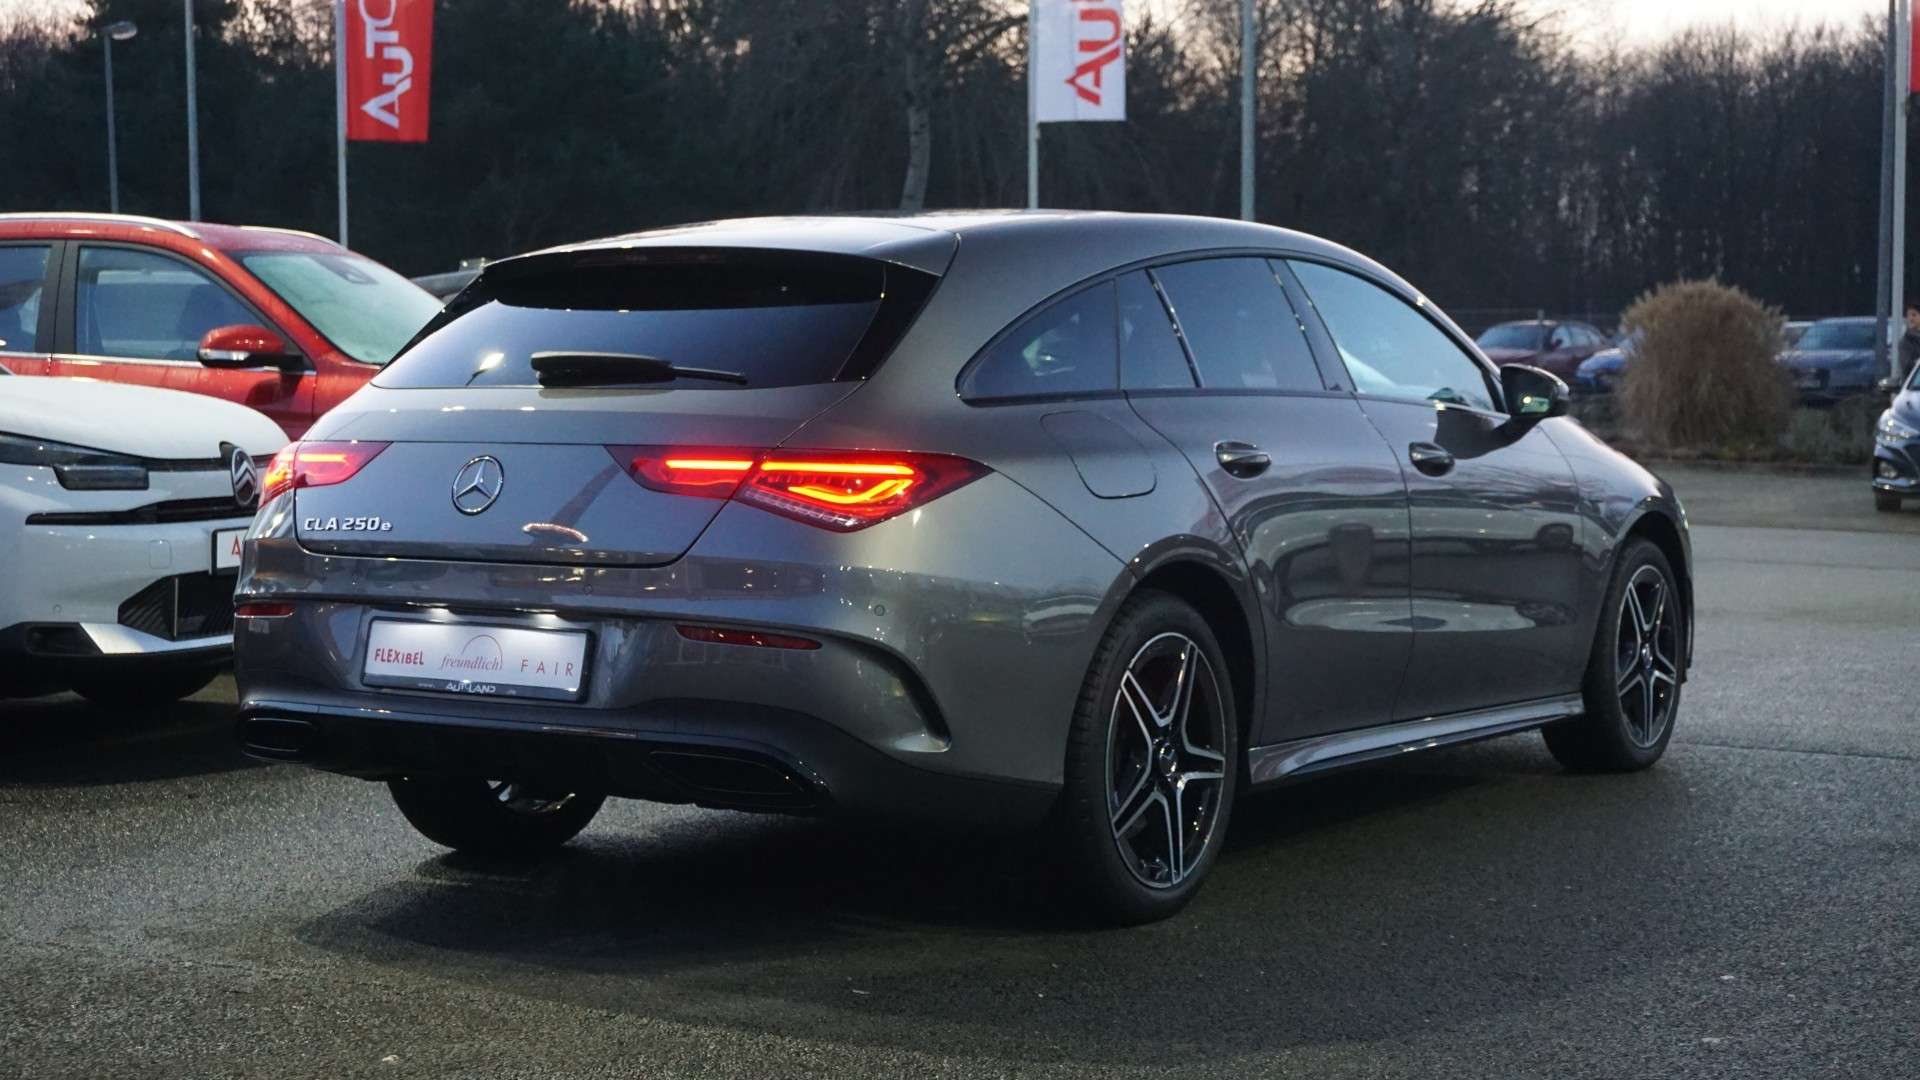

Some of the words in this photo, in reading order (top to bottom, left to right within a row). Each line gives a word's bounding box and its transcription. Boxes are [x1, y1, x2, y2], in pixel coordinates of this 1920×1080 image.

[1064, 0, 1121, 106] AU
[304, 517, 339, 531] CLA
[374, 648, 425, 666] FLEXIBEL
[440, 651, 503, 671] freundlich
[520, 659, 574, 677] FAIR
